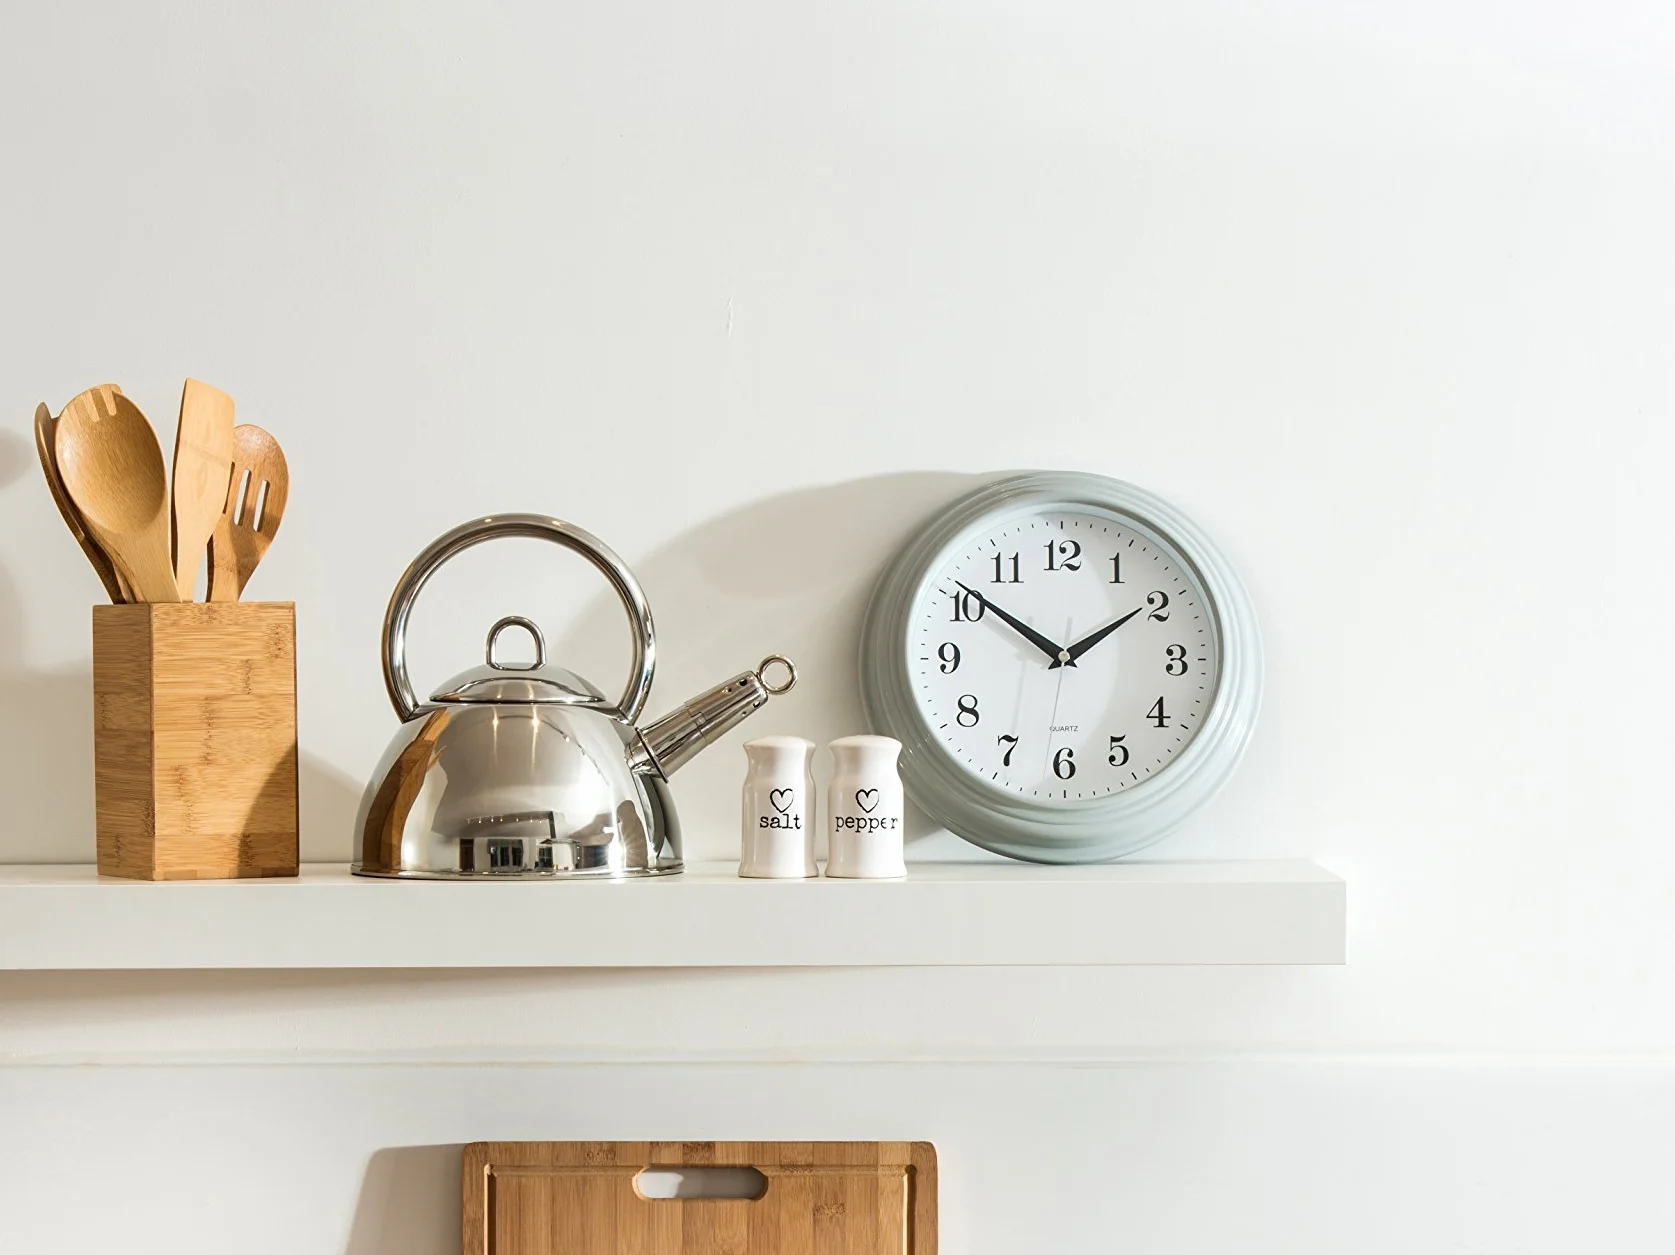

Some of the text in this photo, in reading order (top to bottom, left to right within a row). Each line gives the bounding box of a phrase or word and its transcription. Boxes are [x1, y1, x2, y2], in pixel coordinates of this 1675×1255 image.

[991, 552, 1024, 583] 11
[1043, 540, 1082, 571] 12
[1109, 553, 1125, 584] 1
[949, 590, 985, 622] 10
[1147, 591, 1169, 622] 2
[938, 643, 961, 674] 9
[1166, 645, 1188, 676] 3
[956, 695, 979, 727] 8
[1146, 696, 1171, 728] 4
[998, 735, 1019, 767] 7
[1053, 748, 1076, 780] 6
[1108, 735, 1129, 766] 5
[759, 814, 802, 830] salt
[835, 816, 898, 833] pepper
